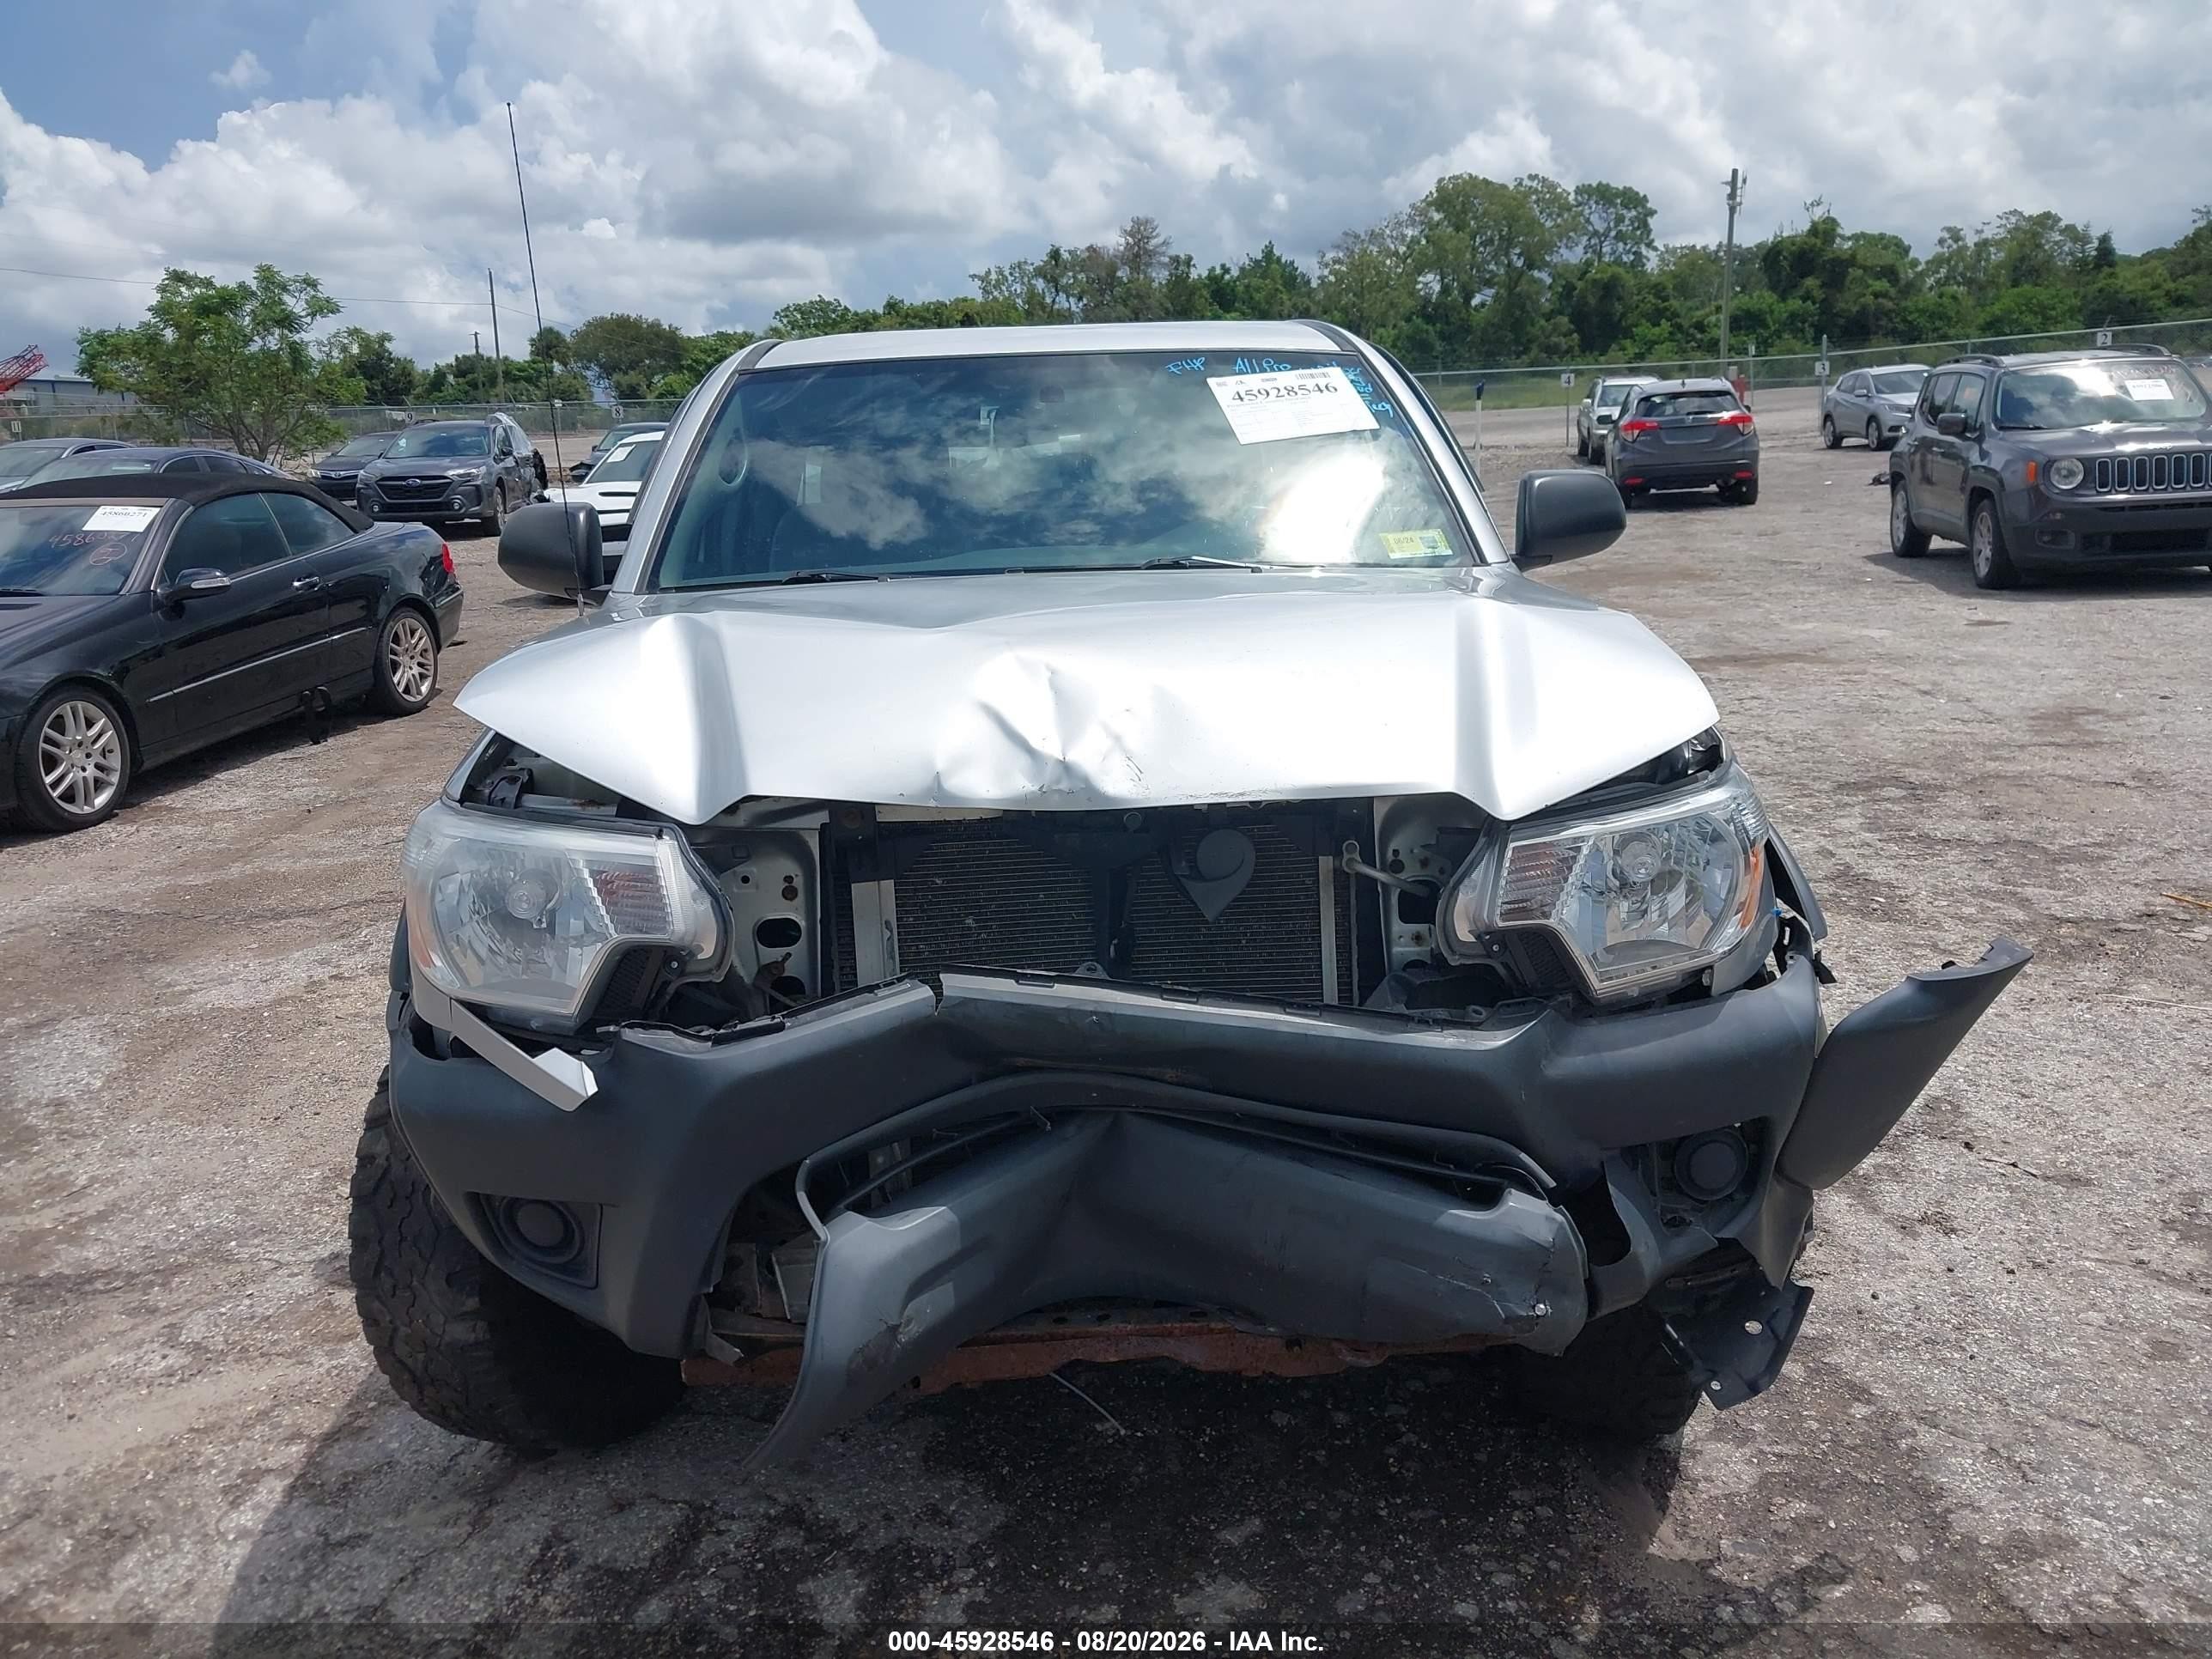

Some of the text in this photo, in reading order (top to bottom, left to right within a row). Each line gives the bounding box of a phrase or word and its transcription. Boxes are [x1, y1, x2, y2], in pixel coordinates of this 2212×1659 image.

[2101, 333, 2108, 344] 2
[1818, 363, 1826, 374] 3
[1564, 375, 1571, 386] 4
[1231, 381, 1339, 403] 45928546
[614, 405, 621, 417] 8
[407, 412, 413, 422] 9
